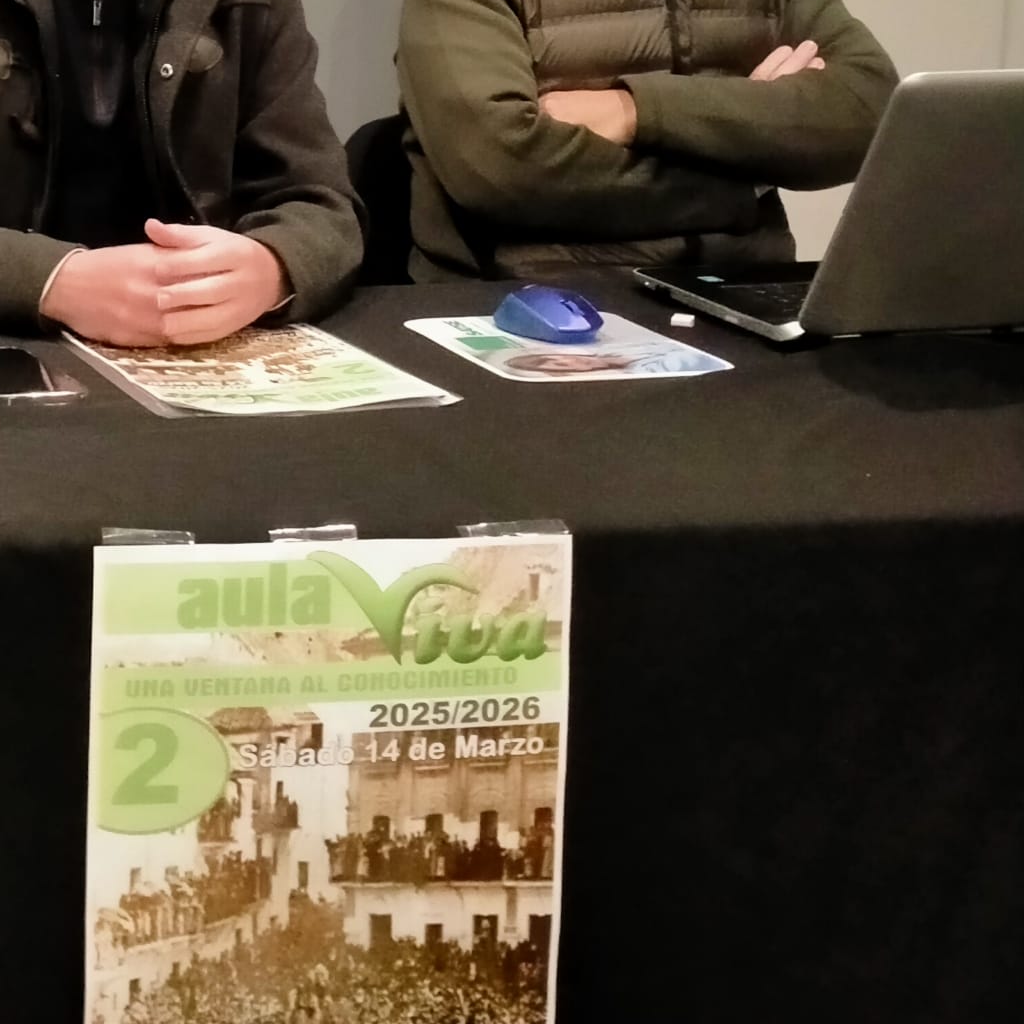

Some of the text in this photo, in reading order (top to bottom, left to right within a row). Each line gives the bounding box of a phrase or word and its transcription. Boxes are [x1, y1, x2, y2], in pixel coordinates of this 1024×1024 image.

[178, 550, 550, 666] aula Viva
[126, 666, 518, 699] UNA VENTANA AL CONOCIMIENTO
[369, 696, 540, 728] 2025/2026
[112, 723, 178, 805] 2
[240, 734, 544, 768] Sábado 14 de Marzo
